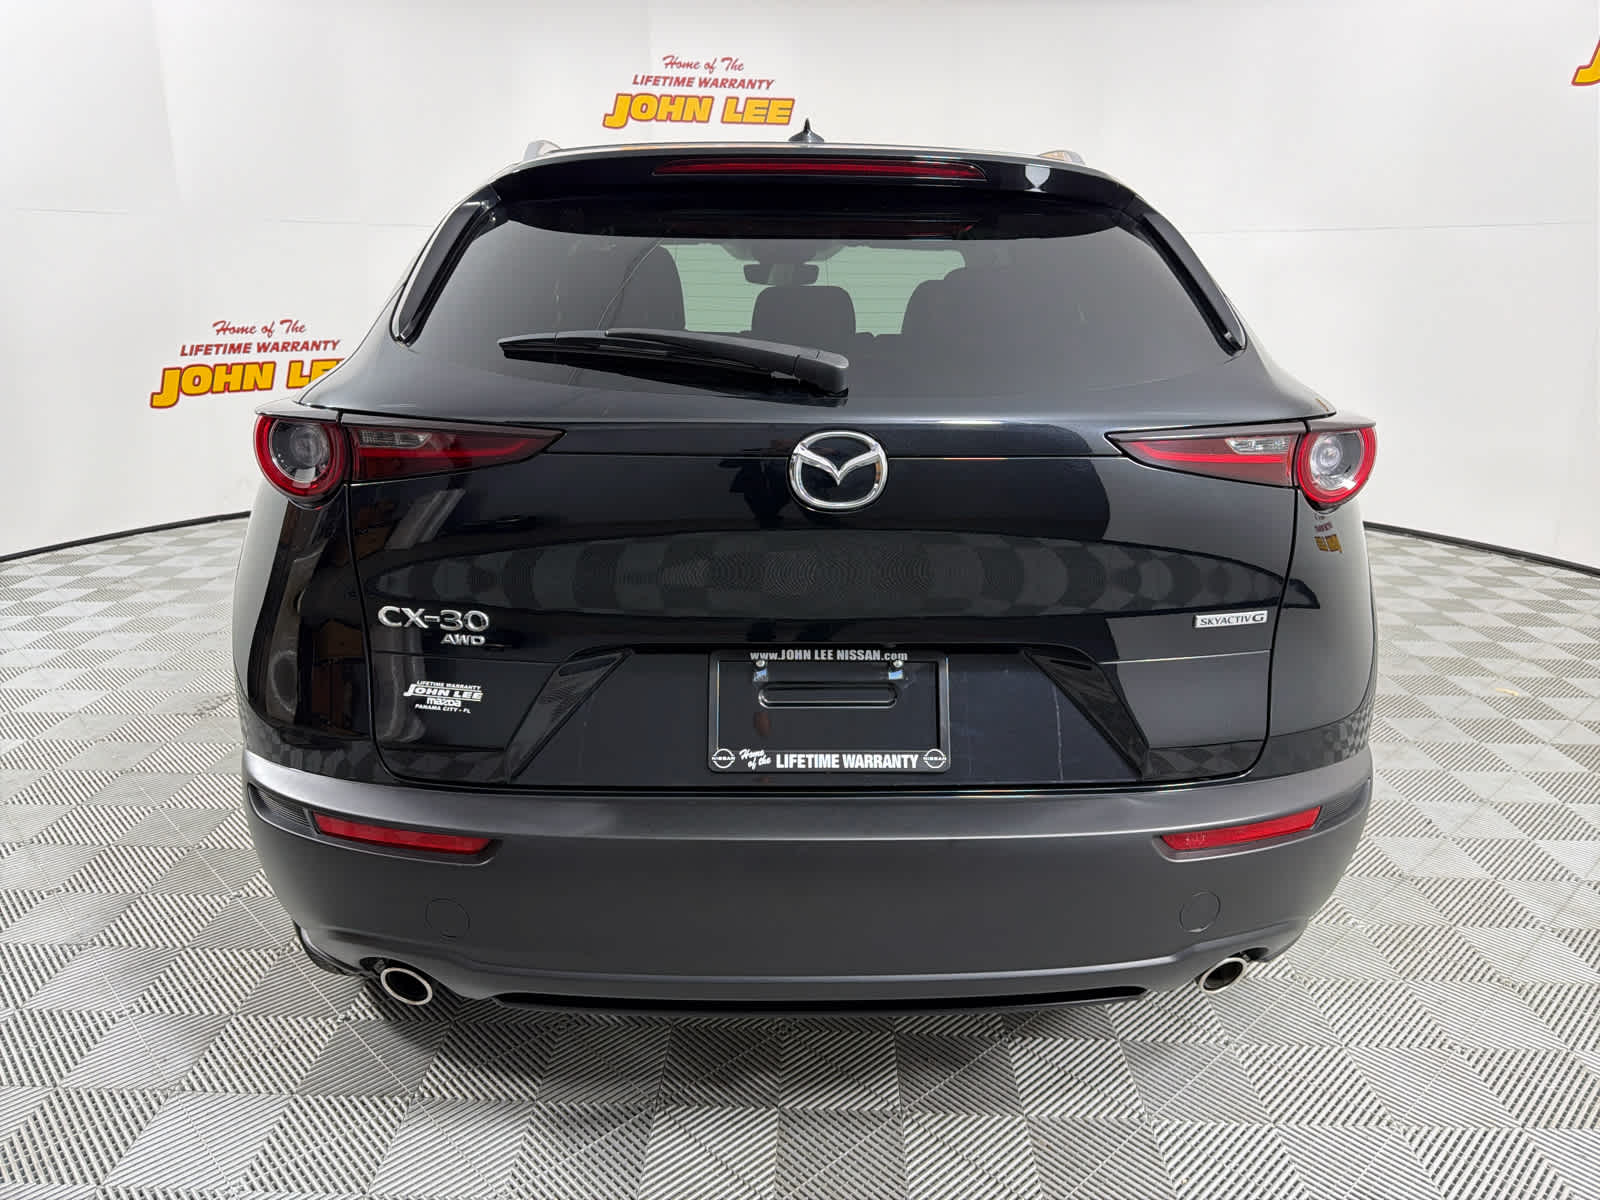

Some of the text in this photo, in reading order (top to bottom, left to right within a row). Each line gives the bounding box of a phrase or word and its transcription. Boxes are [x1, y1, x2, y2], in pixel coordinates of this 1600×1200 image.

[662, 55, 744, 73] Home of The
[632, 74, 775, 90] LIFETIME WARRANTY
[603, 93, 795, 129] JOHN LEE
[212, 319, 306, 338] Home of The
[180, 340, 340, 357] LIFETIME WARRANTY
[150, 361, 276, 408] JOHN
[378, 605, 489, 632] CX-30
[440, 633, 486, 646] AWD
[814, 649, 834, 660] LEE
[403, 684, 483, 700] JOHN LEE
[415, 703, 442, 711] PANAMA
[739, 748, 765, 760] Home
[776, 754, 919, 768] LIFETIME WARRANTY
[747, 758, 757, 770] of
